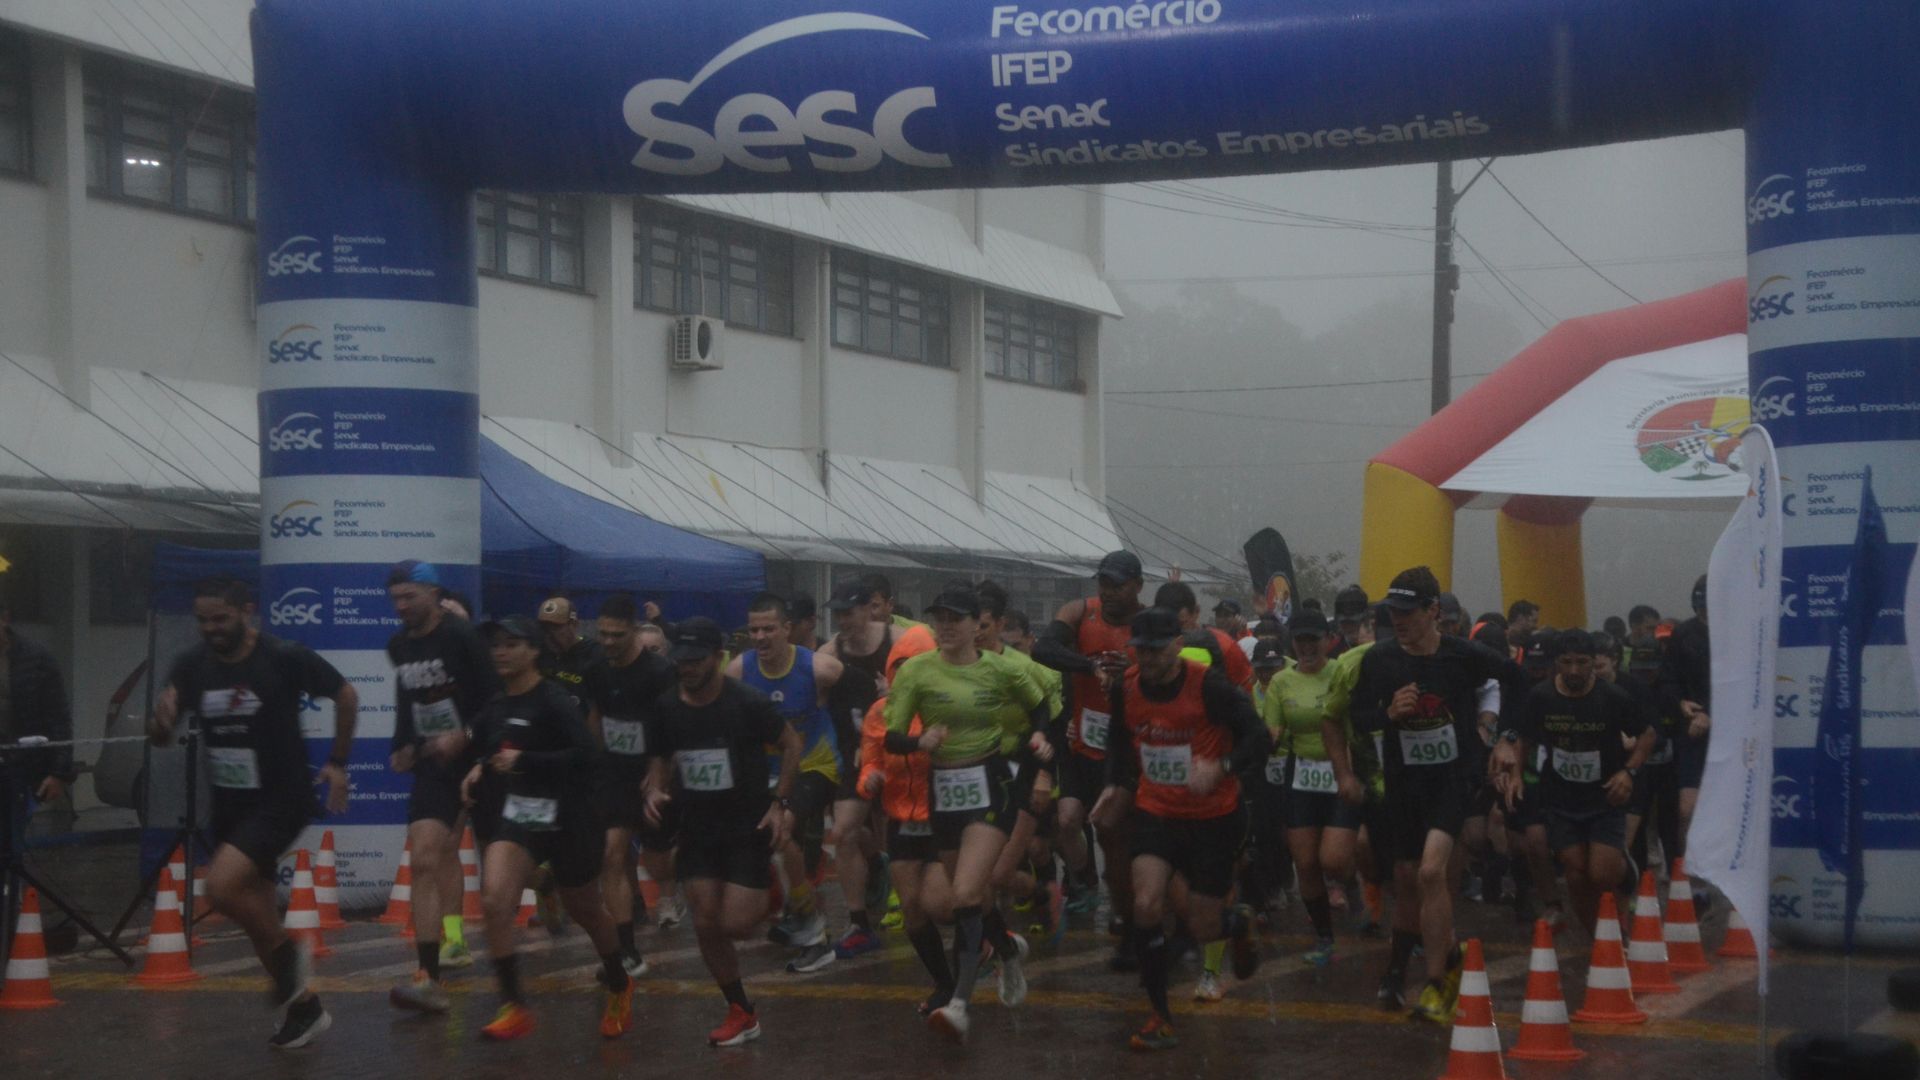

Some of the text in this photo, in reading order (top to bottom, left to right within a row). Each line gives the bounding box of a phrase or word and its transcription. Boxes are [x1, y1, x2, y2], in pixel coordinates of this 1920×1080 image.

[991, 0, 1222, 38] Fecomércio
[991, 50, 1073, 87] IFEP
[622, 78, 952, 175] Sesc
[994, 98, 1111, 132] Senac
[1004, 110, 1490, 168] Sindicatos Empresariais
[1807, 164, 1867, 177] Fecomércio
[332, 235, 386, 245] Fecomércio
[268, 252, 323, 277] Sesc
[269, 340, 323, 364] Sesc
[333, 411, 386, 421] Fecomércio
[269, 427, 323, 452] Sesc
[270, 514, 323, 539] Sesc
[333, 586, 386, 596] Fecomércio
[270, 601, 323, 626] Sesc
[1410, 740, 1452, 761] 490
[1147, 761, 1187, 781] 455
[1300, 768, 1334, 789] 399
[940, 783, 982, 808] 395
